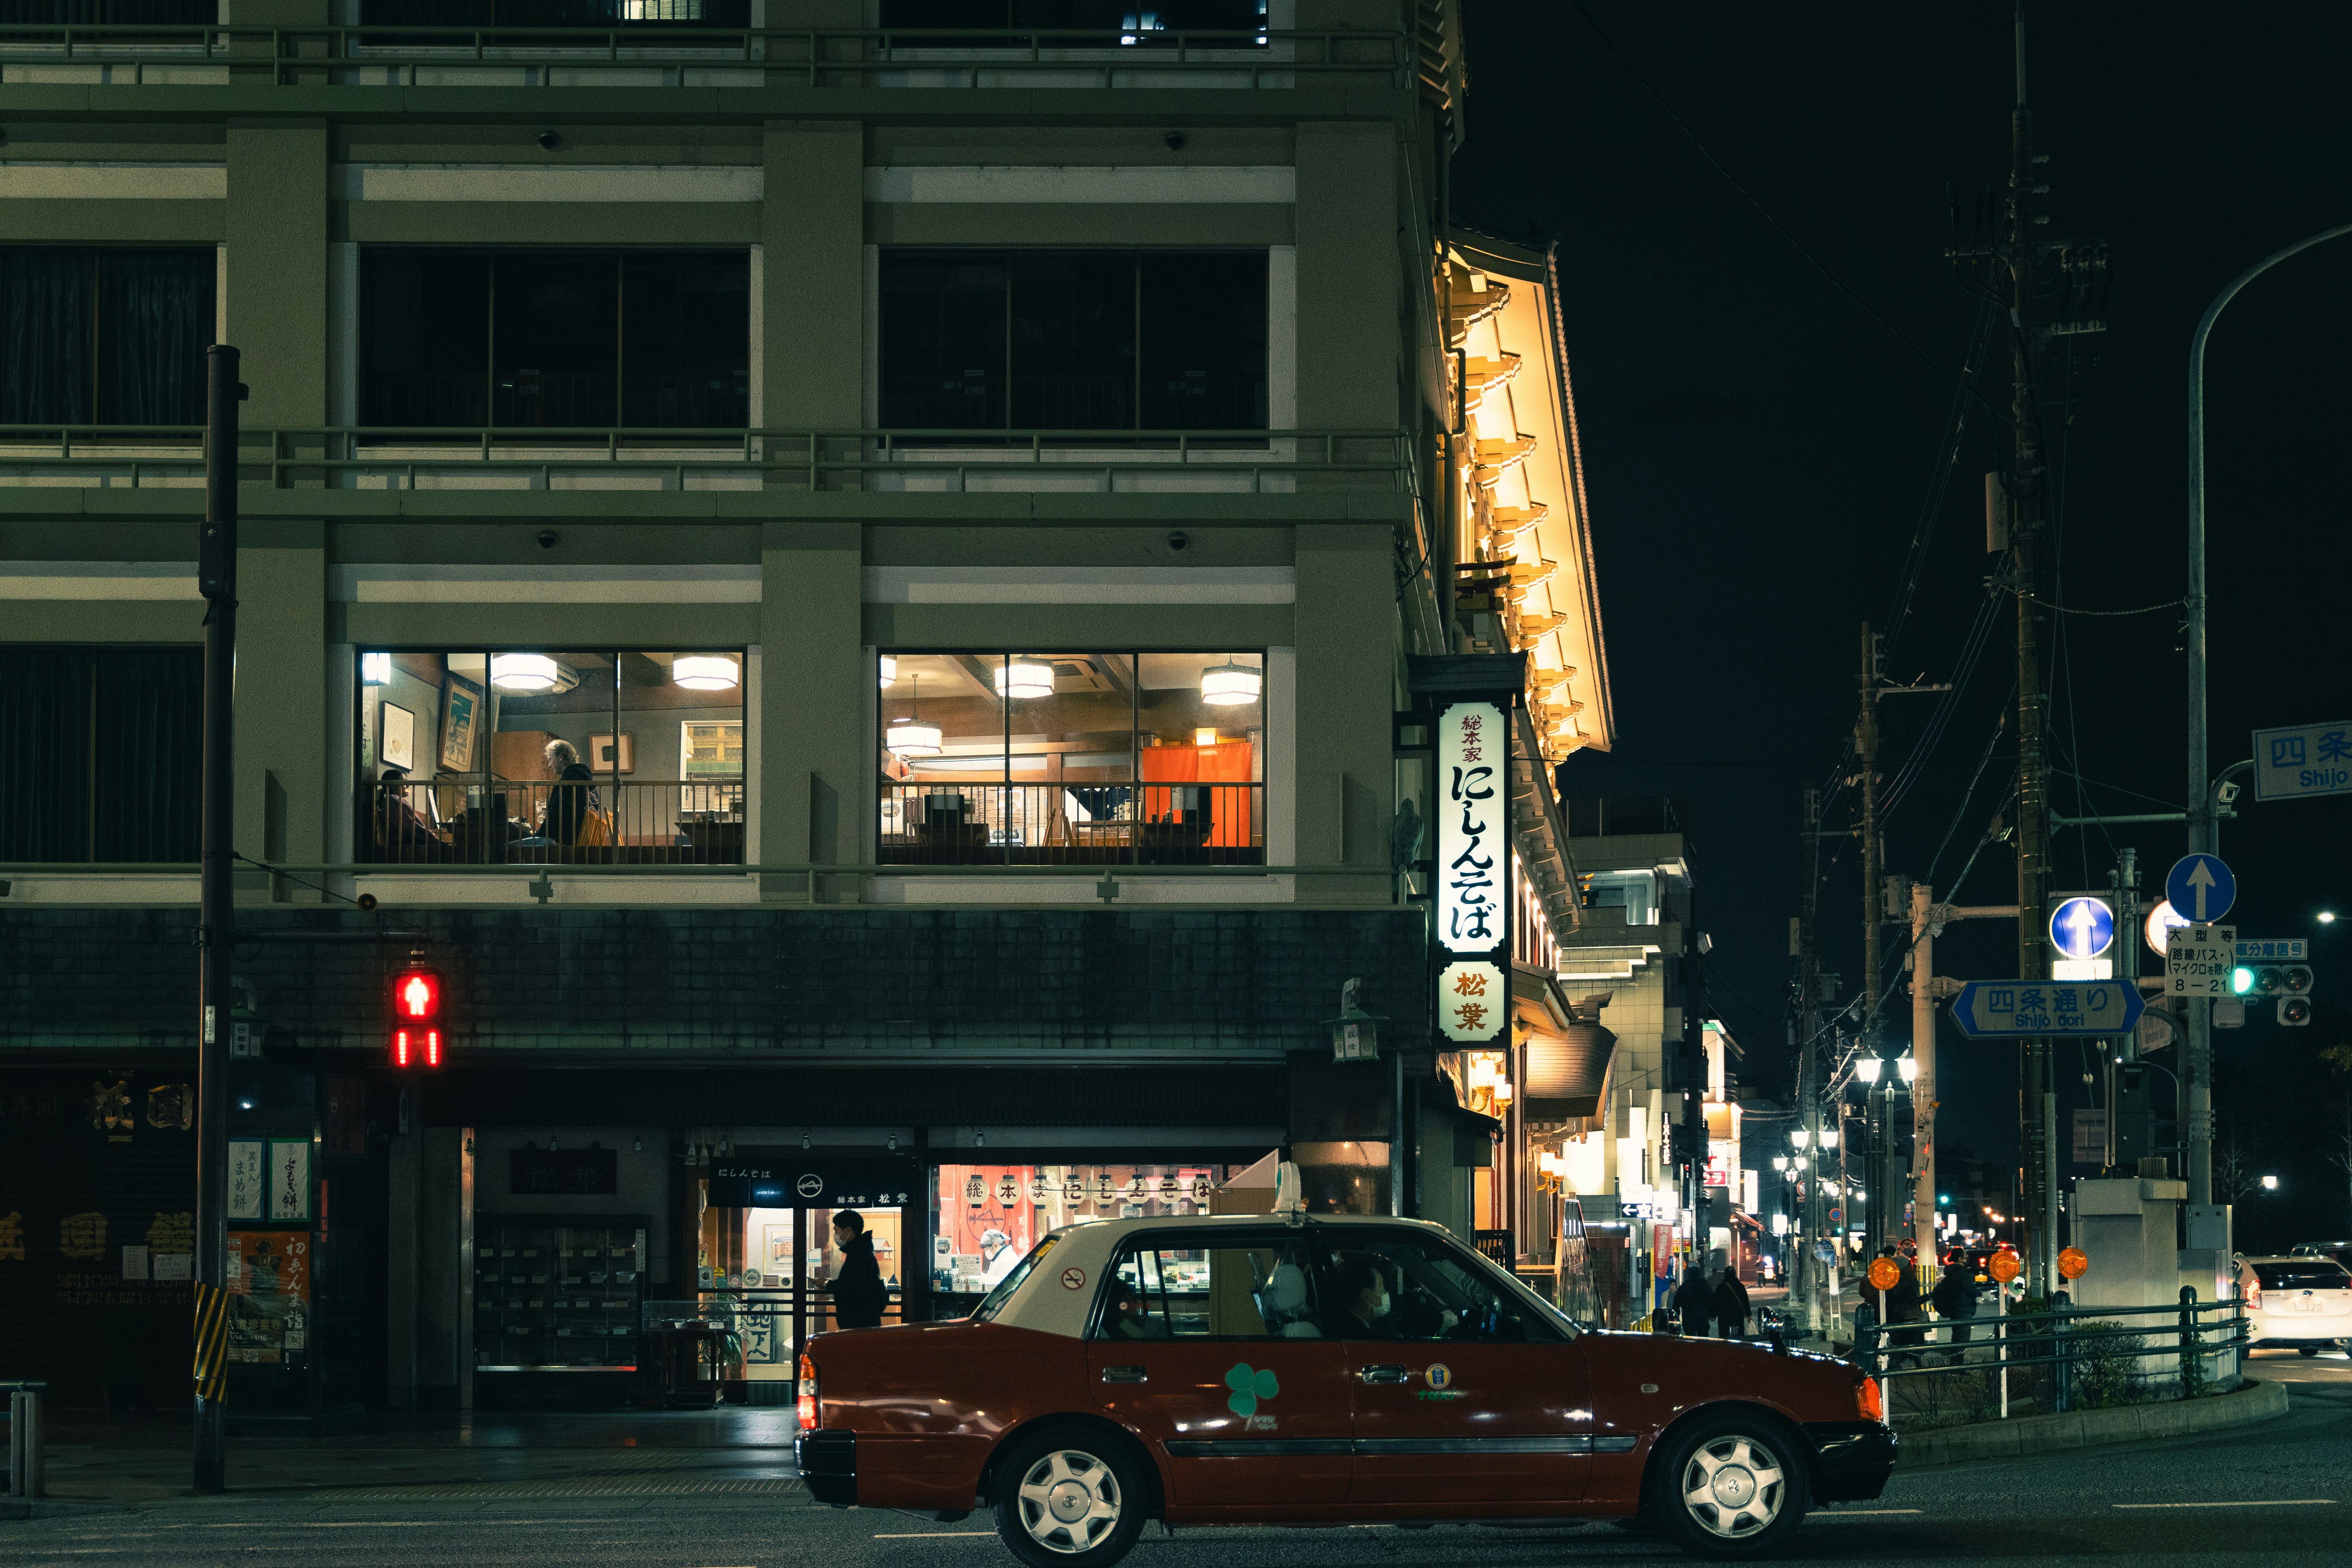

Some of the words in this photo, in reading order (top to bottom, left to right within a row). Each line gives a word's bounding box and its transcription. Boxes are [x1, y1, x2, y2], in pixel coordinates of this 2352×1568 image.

[1461, 715, 1483, 763] 総本家
[2300, 768, 2348, 788] Shijo
[1450, 766, 1497, 939] にしんそば
[2169, 929, 2233, 942] 大型等
[1453, 972, 1489, 1031] 松葉
[1989, 988, 2108, 1013] 四条通り
[2015, 1014, 2051, 1029] Shijo
[2058, 1013, 2084, 1027] dori
[282, 1157, 297, 1211] よもぎ餅
[523, 1165, 603, 1192] 松葉
[718, 1169, 771, 1179] にしんそば
[878, 1193, 908, 1204] 松葉
